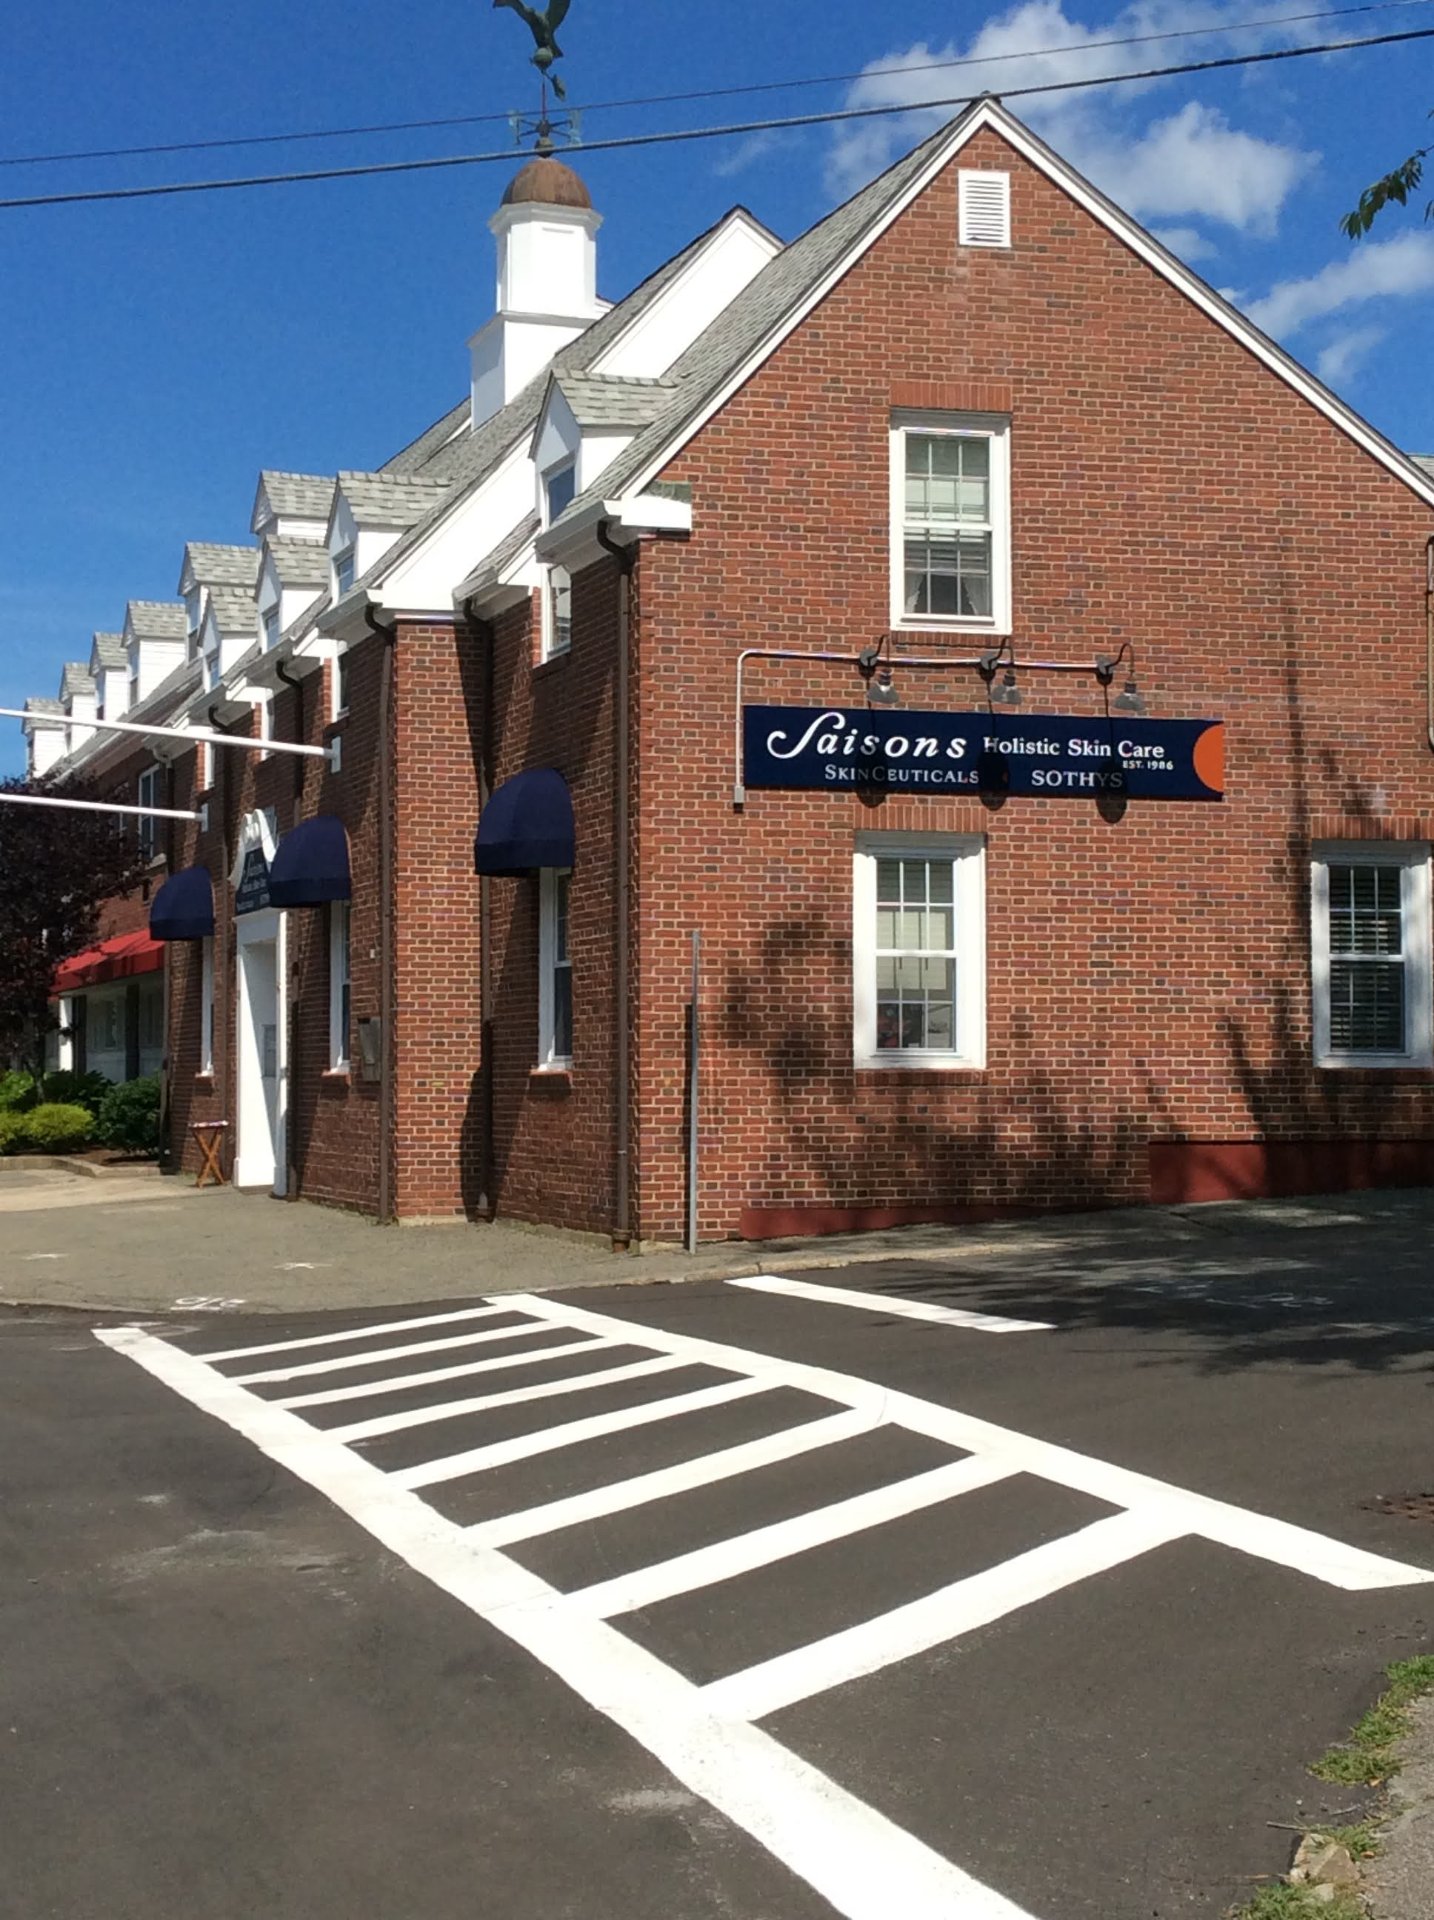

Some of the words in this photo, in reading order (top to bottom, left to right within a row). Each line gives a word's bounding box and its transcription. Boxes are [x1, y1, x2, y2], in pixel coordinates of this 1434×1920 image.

[766, 711, 967, 759] Saisons
[983, 736, 1060, 756] Holistic
[1067, 738, 1112, 757] Skin
[1117, 740, 1165, 758] Care
[824, 763, 979, 784] SKINCEUTICALS
[1122, 760, 1145, 769] EST.
[1147, 760, 1174, 771] 1986
[1031, 769, 1123, 788] SOTHYS
